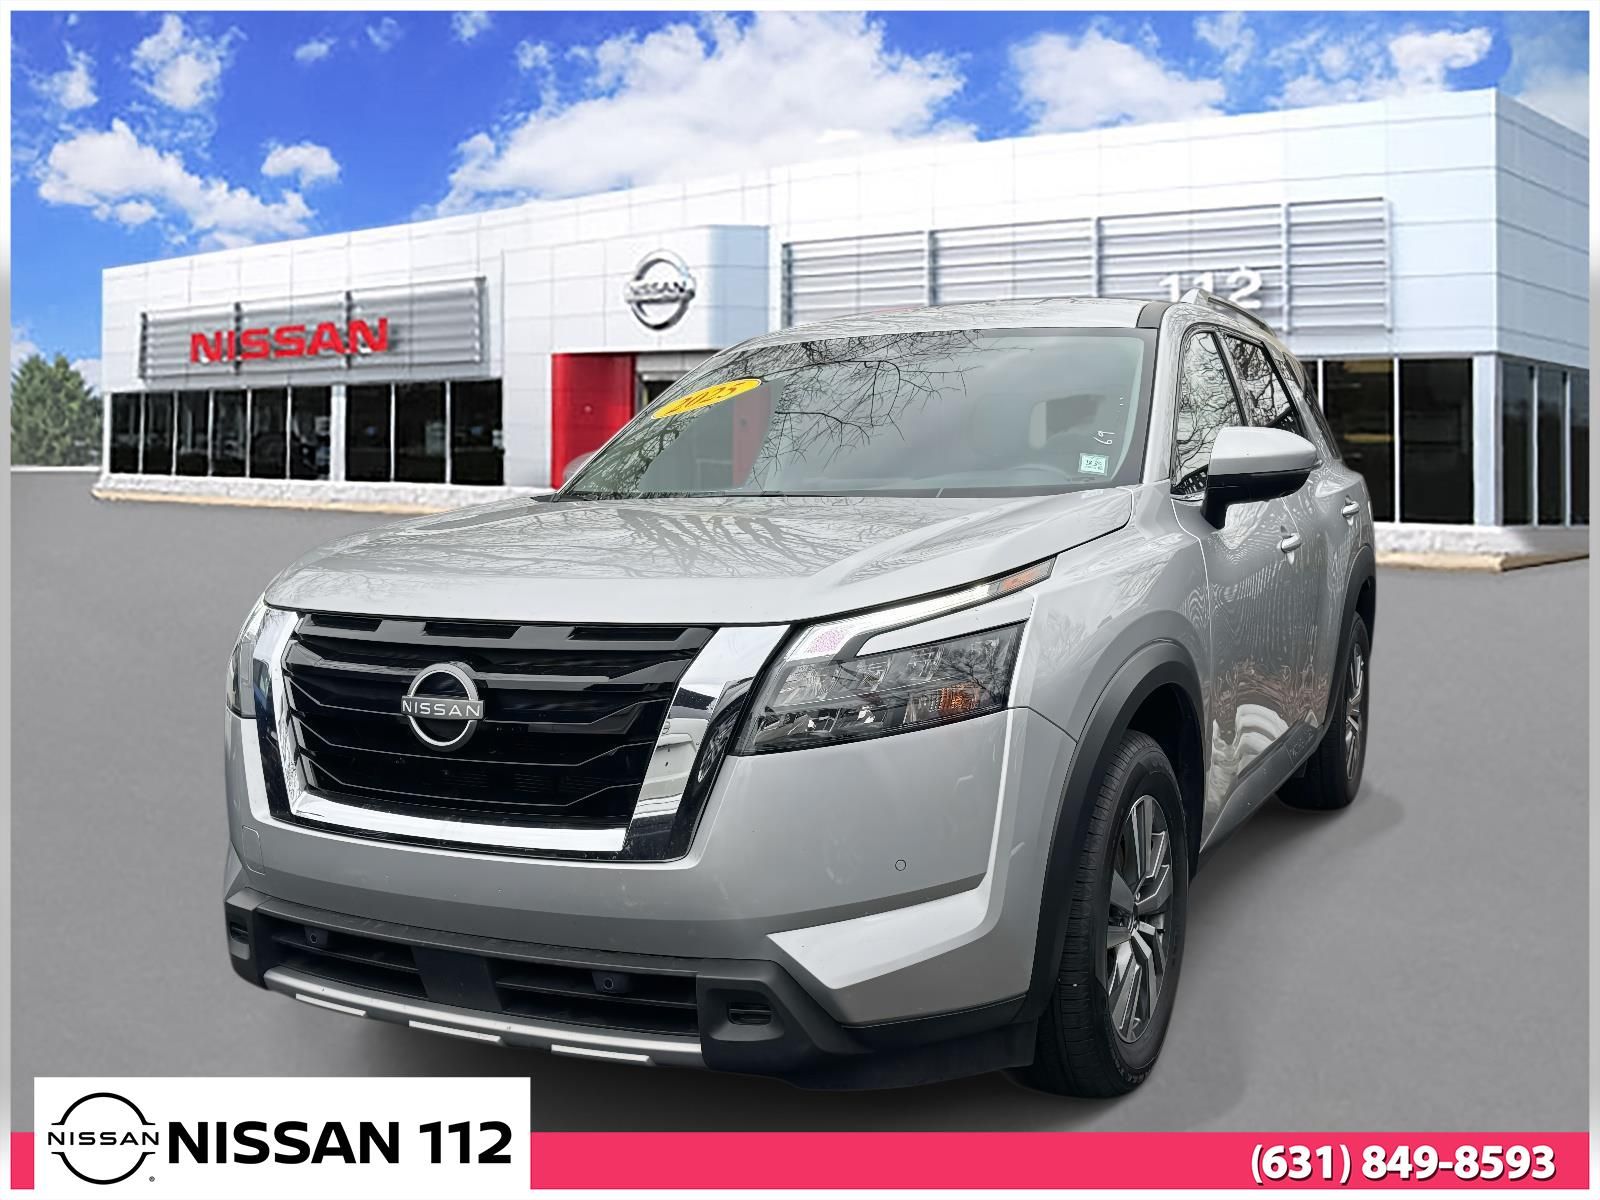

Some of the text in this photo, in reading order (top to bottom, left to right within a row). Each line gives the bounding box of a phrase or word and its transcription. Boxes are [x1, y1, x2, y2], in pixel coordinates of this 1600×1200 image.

[1158, 270, 1263, 309] 112
[190, 316, 389, 364] NISSAN
[664, 381, 747, 415] 2025
[402, 700, 480, 717] NISSAN
